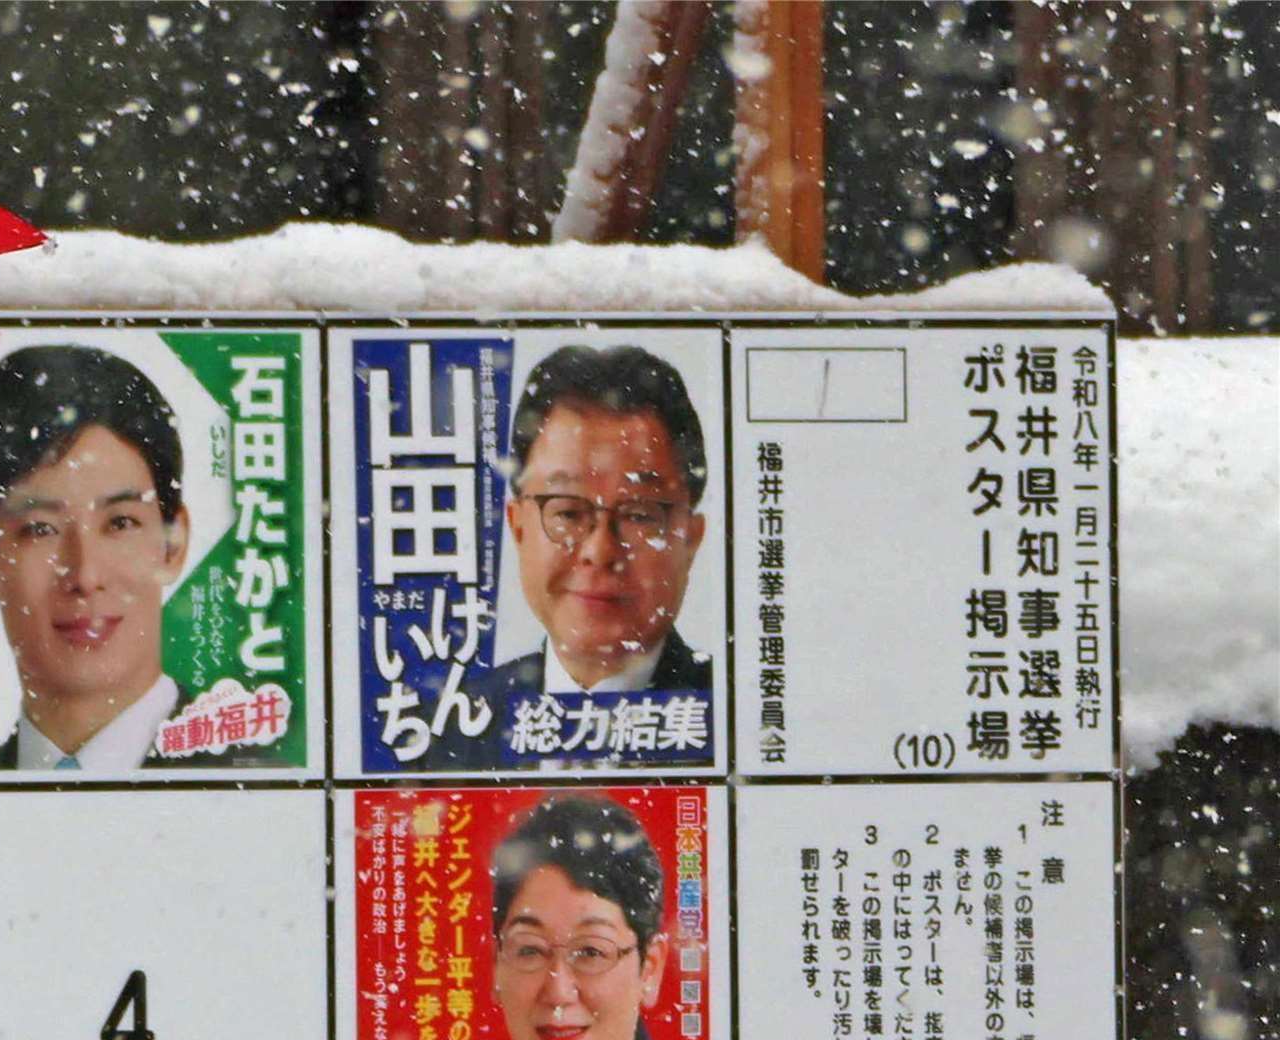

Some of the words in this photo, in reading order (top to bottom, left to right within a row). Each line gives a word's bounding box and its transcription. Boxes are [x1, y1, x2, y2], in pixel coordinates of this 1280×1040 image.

[230, 356, 291, 672] 石田たかと
[369, 342, 479, 586] 山田
[373, 591, 426, 611] やまだ
[757, 441, 786, 765] 福井市選挙管理委員会
[964, 343, 1010, 761] ポスター掲示場
[1016, 346, 1062, 761] 福井県知事選挙
[1072, 345, 1101, 730] 令和八年一月二十五日執行
[162, 690, 286, 753] 躍動福井
[509, 697, 711, 753] 総力結集
[893, 732, 956, 770] (10)
[677, 796, 703, 939] 日本共産党
[863, 823, 879, 846] 3
[925, 823, 940, 845] 2
[953, 847, 975, 927] ません。
[800, 847, 823, 1001] 罰せられます。
